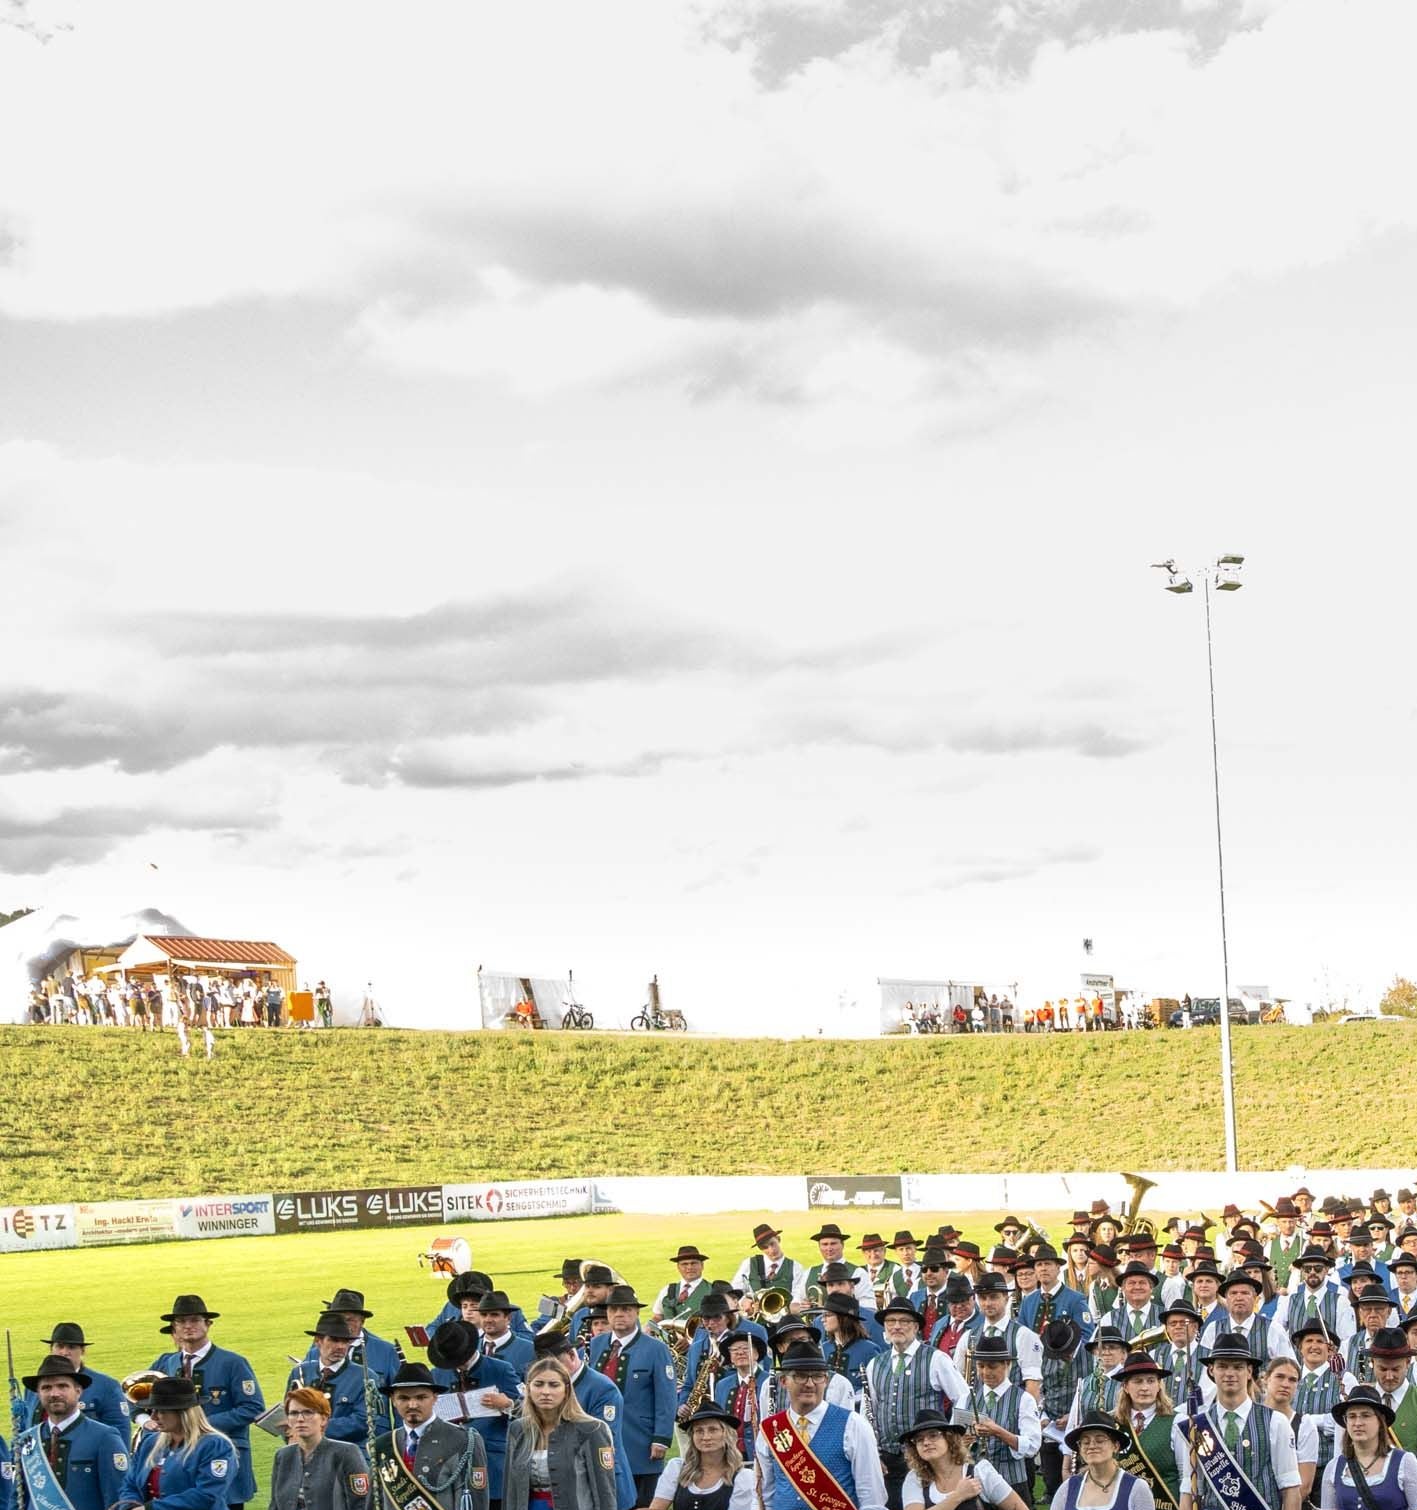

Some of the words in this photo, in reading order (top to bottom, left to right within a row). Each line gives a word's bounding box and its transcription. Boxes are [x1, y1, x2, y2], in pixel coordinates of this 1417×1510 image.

[195, 1201, 269, 1217] INTERSPORT
[296, 1196, 359, 1219] LUKS
[385, 1192, 442, 1214] LUKS
[447, 1195, 483, 1211] SITEK
[197, 1218, 258, 1232] WINNINGER
[806, 1487, 818, 1498] St.
[819, 1492, 848, 1508] Georgen
